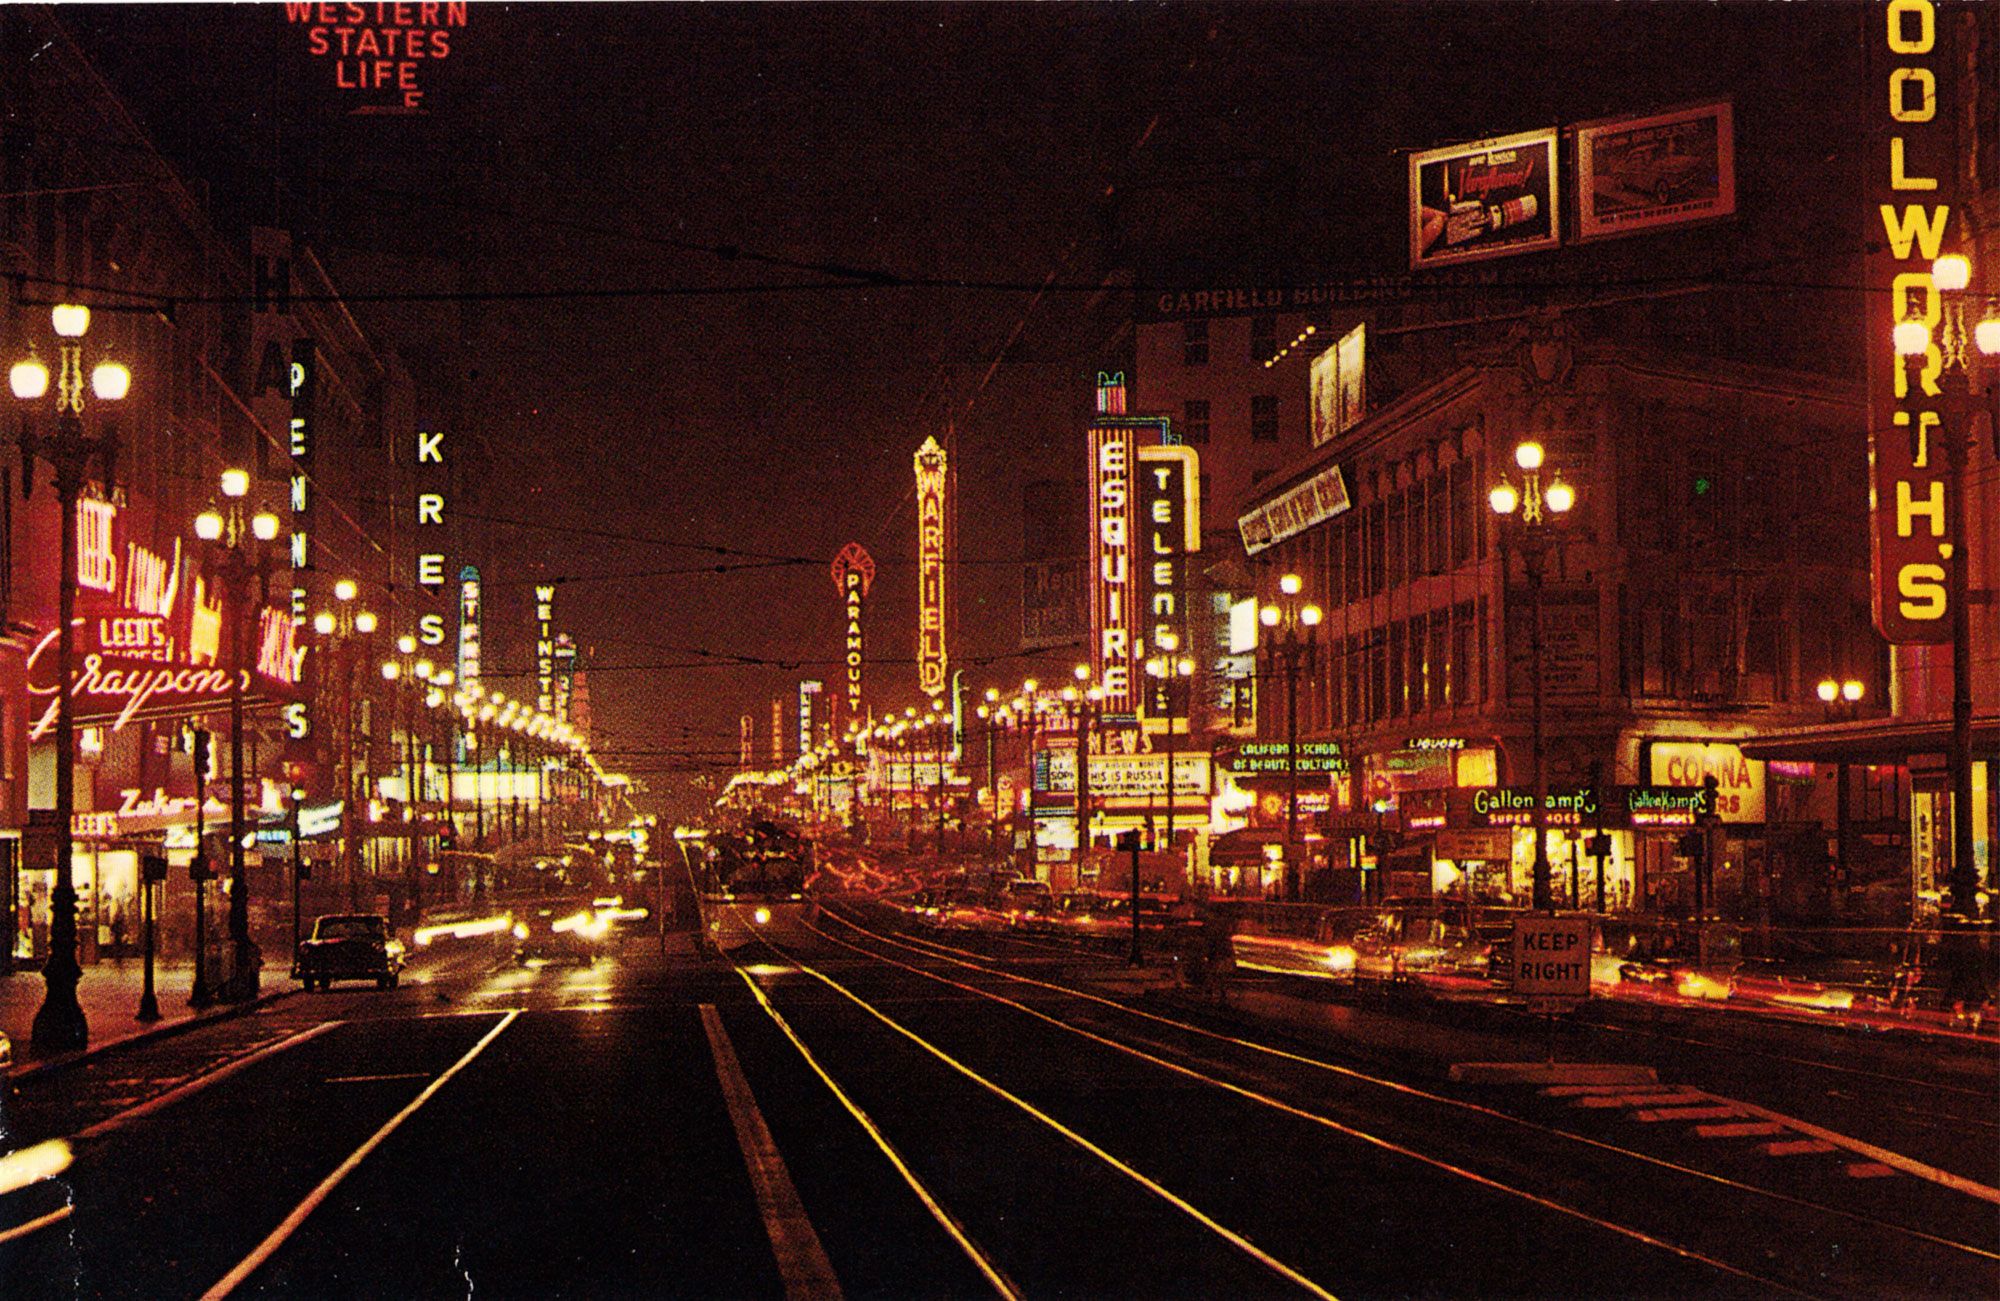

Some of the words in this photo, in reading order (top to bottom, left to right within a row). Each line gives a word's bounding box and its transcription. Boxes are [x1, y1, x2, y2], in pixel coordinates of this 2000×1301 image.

[285, 2, 467, 26] WESTERN
[309, 26, 450, 59] STATES
[336, 60, 418, 89] LIFE
[1158, 288, 1283, 313] GARFIELD
[418, 432, 447, 695] KRES
[1100, 441, 1127, 696] ESQUIRE
[917, 470, 941, 685] WARFIELD
[846, 573, 861, 711] PARAMOUNT
[1088, 729, 1153, 754] NEWS
[1303, 743, 1341, 755] SCHOOL
[1409, 737, 1466, 749] LIQUORS
[1090, 771, 1107, 782] HIS
[1126, 769, 1163, 782] RUSSIA
[1233, 759, 1247, 770] OF
[1488, 812, 1532, 825] SUPER
[1523, 931, 1580, 951] KEEP
[1520, 961, 1583, 981] RIGHT
